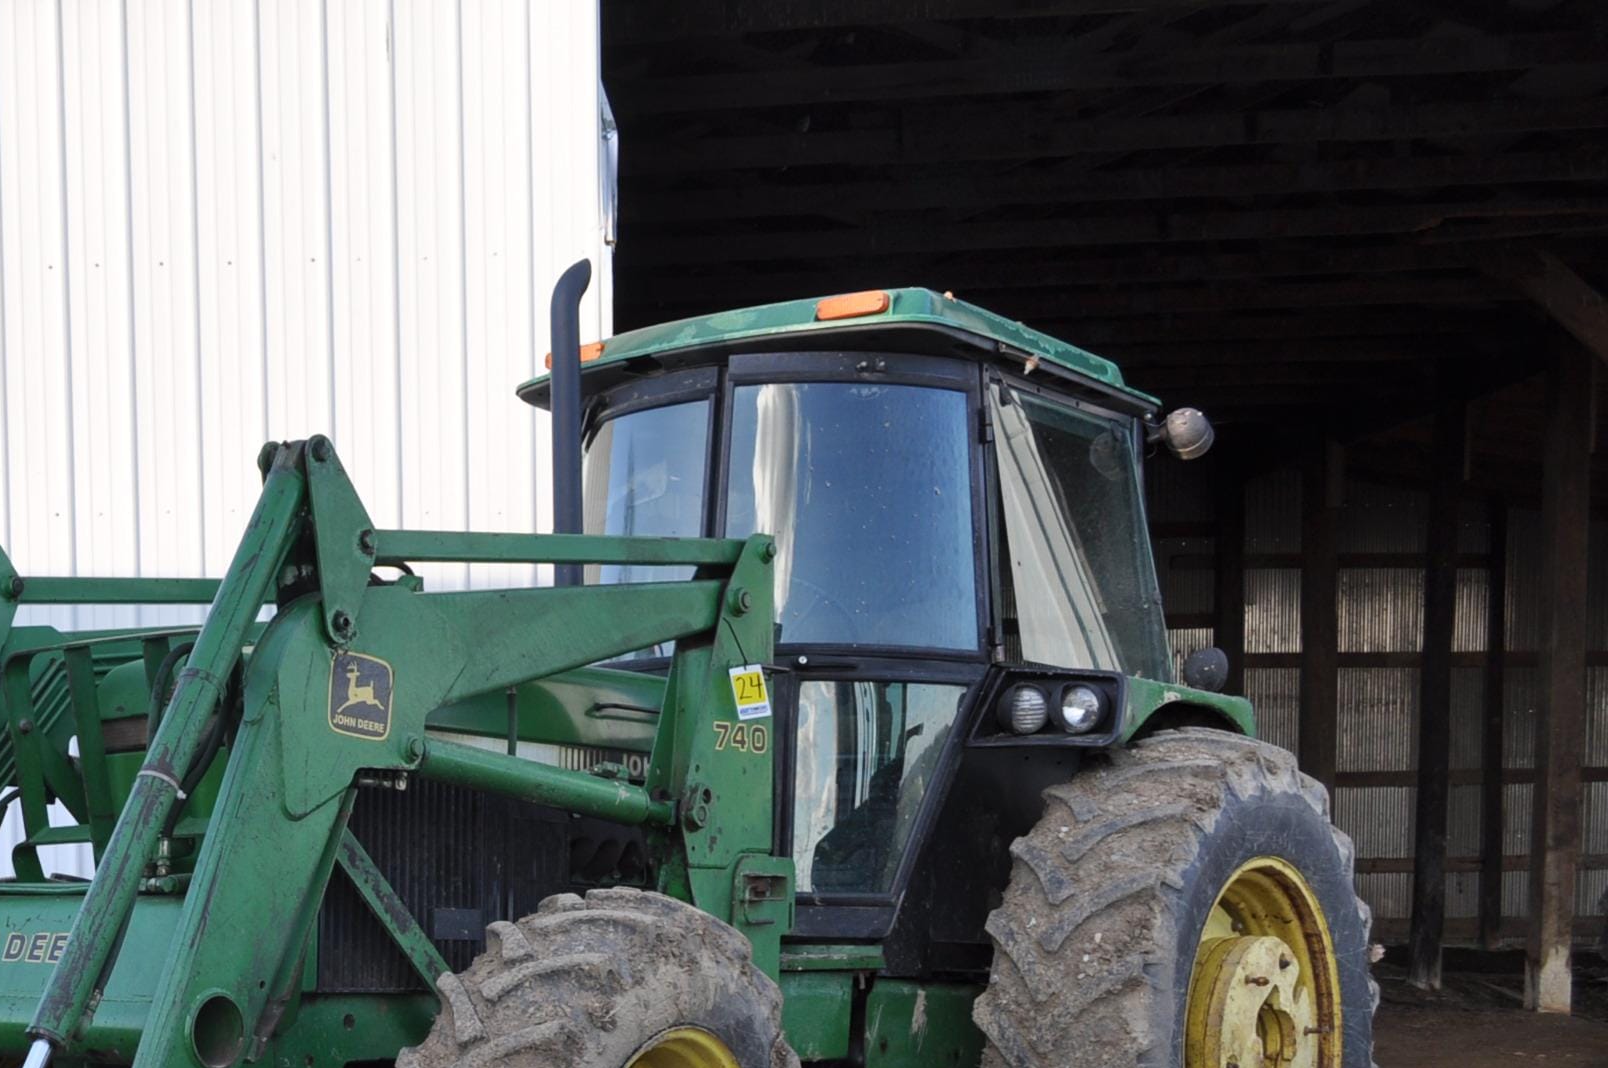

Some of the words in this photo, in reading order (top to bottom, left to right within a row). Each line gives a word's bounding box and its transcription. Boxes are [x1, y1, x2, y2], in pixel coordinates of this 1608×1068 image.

[736, 674, 762, 700] 24
[333, 714, 356, 728] JOHN
[357, 718, 385, 733] DEERE
[713, 721, 767, 754] 740
[2, 931, 74, 964] DEE
